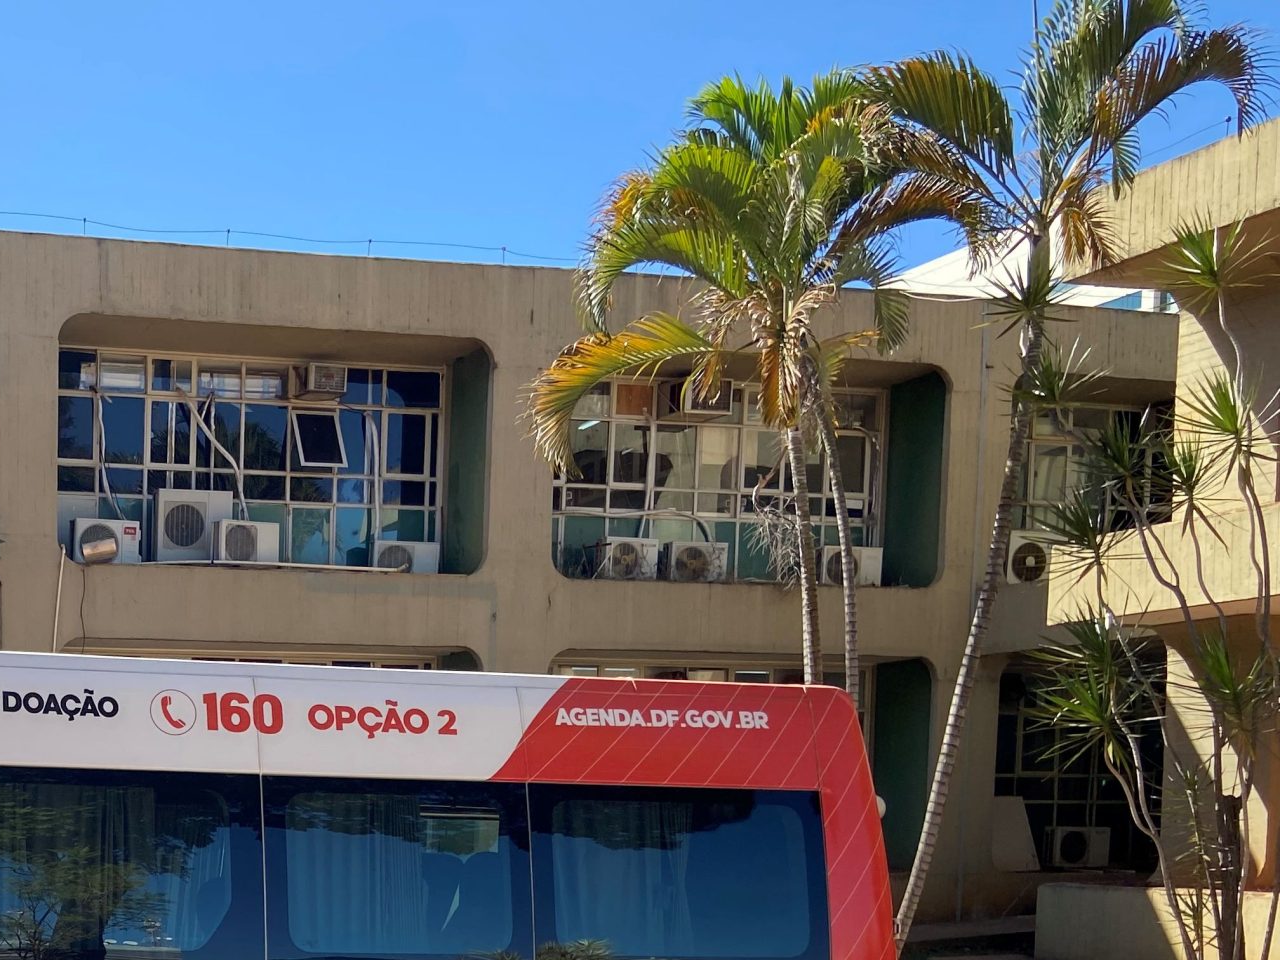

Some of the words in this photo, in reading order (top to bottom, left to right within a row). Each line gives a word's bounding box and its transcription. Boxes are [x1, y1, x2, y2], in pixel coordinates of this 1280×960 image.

[2, 688, 119, 722] DOAÇÃO
[202, 692, 284, 735] 160
[307, 699, 430, 739] OPÇÃO
[437, 709, 458, 736] 2
[555, 707, 770, 730] AGENDA.DF.GOV.BR
